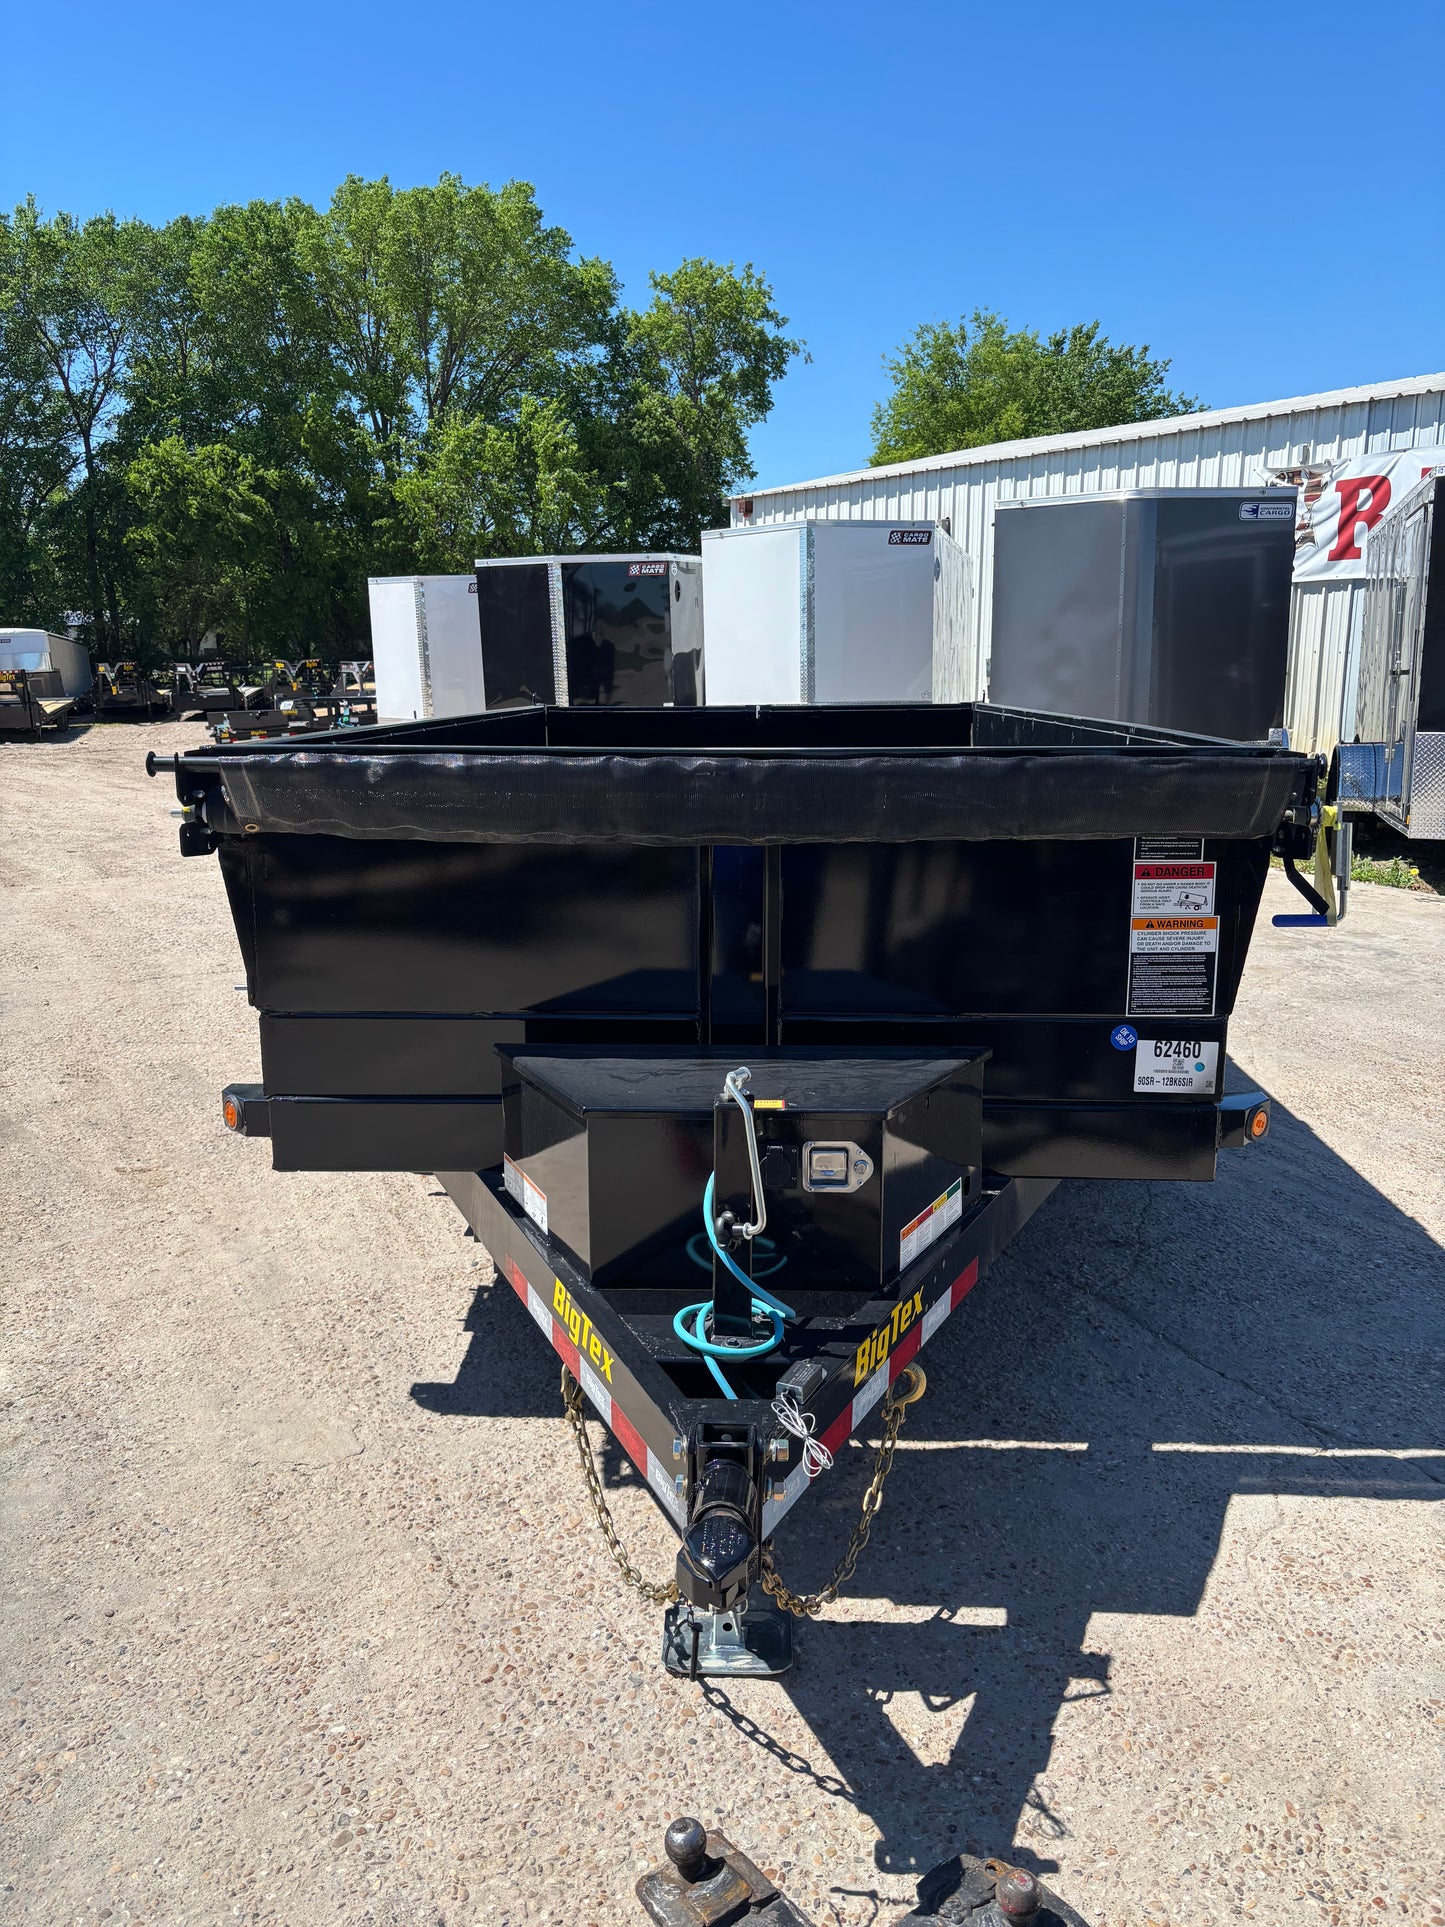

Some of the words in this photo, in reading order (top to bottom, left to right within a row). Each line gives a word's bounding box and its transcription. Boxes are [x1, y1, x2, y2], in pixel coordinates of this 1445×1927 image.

[1156, 867, 1204, 876] DANGER
[1115, 1034, 1128, 1046] SHIP
[1120, 1028, 1130, 1037] OK
[1127, 1034, 1135, 1044] TO
[1154, 1040, 1201, 1058] 62460
[552, 1276, 614, 1384] BigTex
[854, 1286, 924, 1388] BigTex
